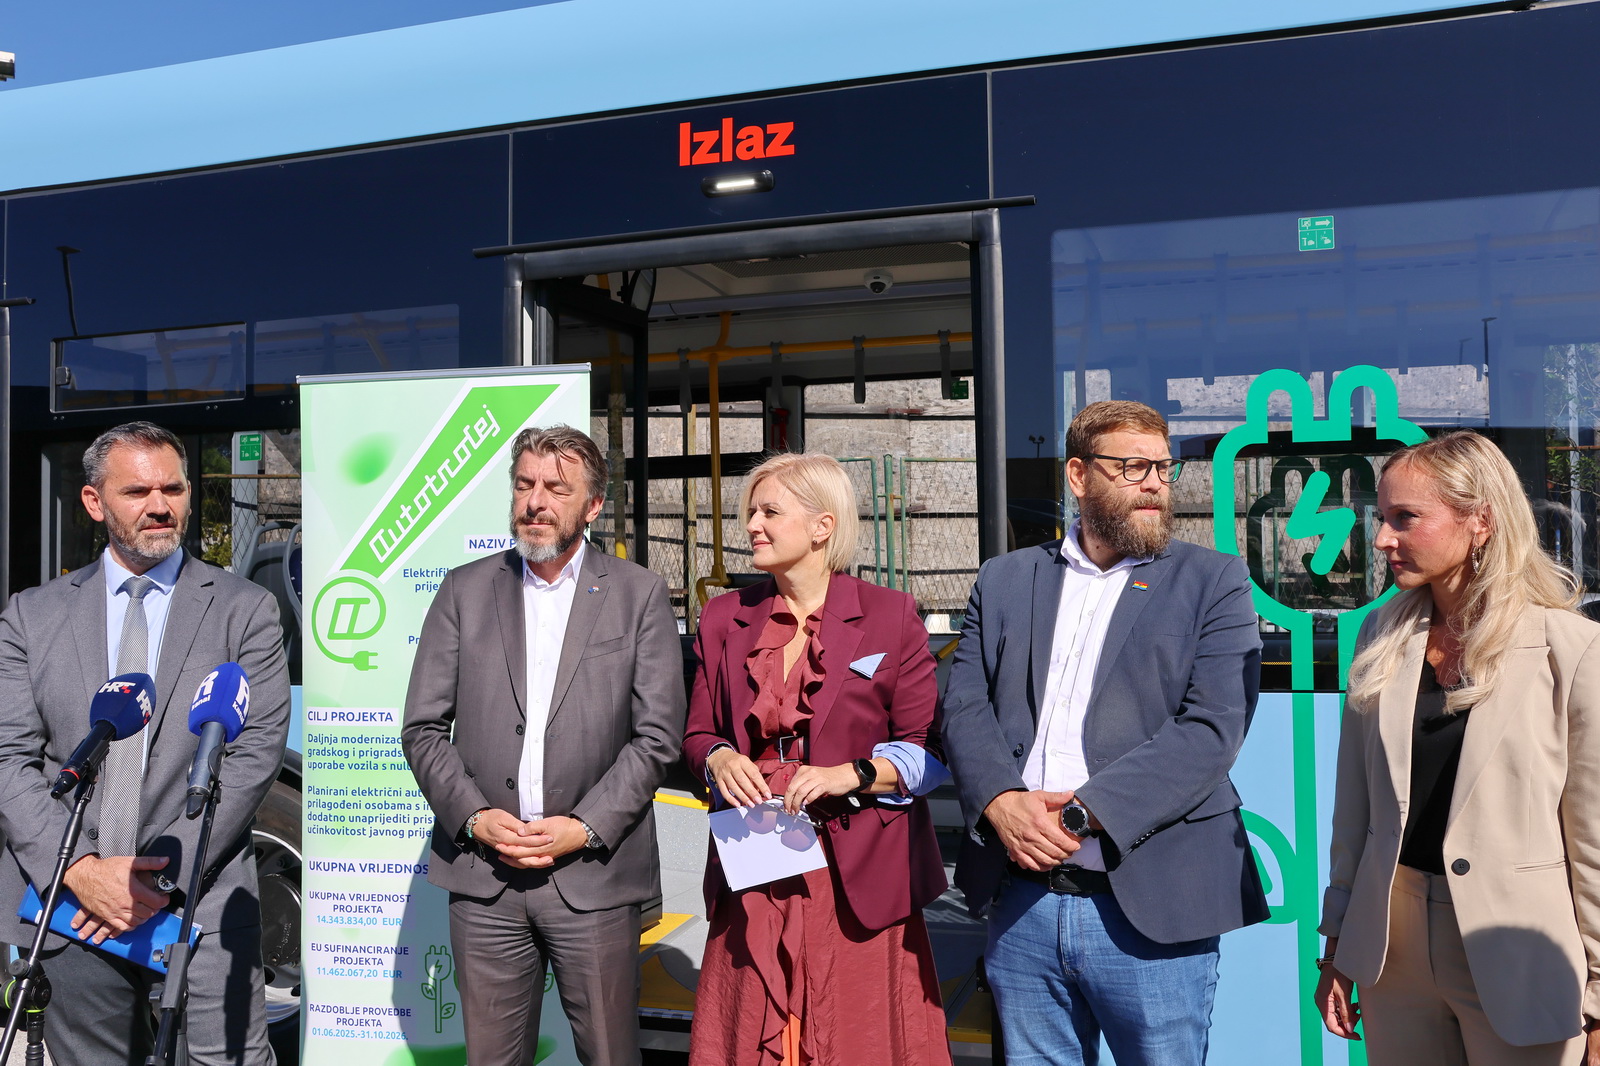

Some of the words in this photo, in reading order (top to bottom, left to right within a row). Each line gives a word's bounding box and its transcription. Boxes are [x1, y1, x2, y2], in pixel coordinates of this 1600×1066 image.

[679, 117, 795, 167] Izlaz
[469, 539, 506, 549] NAZIV
[403, 568, 448, 578] Elektrifi
[415, 581, 441, 593] prije
[98, 681, 136, 694] HRT
[307, 711, 328, 722] CILJ
[331, 711, 394, 722] PROJEKTA
[307, 733, 339, 745] Daljnja
[307, 748, 350, 759] gradskog
[352, 747, 356, 757] i
[358, 748, 405, 759] prigrads
[307, 760, 345, 770] uporabe
[347, 760, 379, 771] vozila
[381, 763, 387, 771] s
[307, 785, 348, 797] Planirani
[351, 786, 402, 797] električni
[307, 799, 362, 810] prilagođeni
[364, 800, 412, 811] osobama
[415, 803, 420, 811] s
[307, 811, 345, 823] dodatno
[348, 814, 410, 825] unaprijediti
[307, 825, 367, 836] učinkovitost
[368, 827, 405, 839] javnog
[309, 861, 356, 873] UKUPNA
[359, 863, 429, 875] VRIJEDNOS
[309, 891, 346, 901] UKUPNA
[348, 893, 411, 903] VRIJEDNOST
[333, 904, 383, 914] PROJEKTA
[316, 915, 378, 926] 14.343.834,00
[382, 917, 402, 926] EUR
[311, 943, 322, 952] EU
[324, 944, 409, 955] SUFINANCIRANJE
[333, 956, 384, 966] PROJEKTA
[316, 967, 378, 978] 11.462.067,20
[383, 970, 402, 978] EUR
[309, 1003, 360, 1015] RAZDOBLJE
[362, 1007, 412, 1017] PROVEDBE
[336, 1018, 382, 1027] PROJEKTA
[312, 1027, 408, 1040] 01.06.2025.-31.10.2026.
